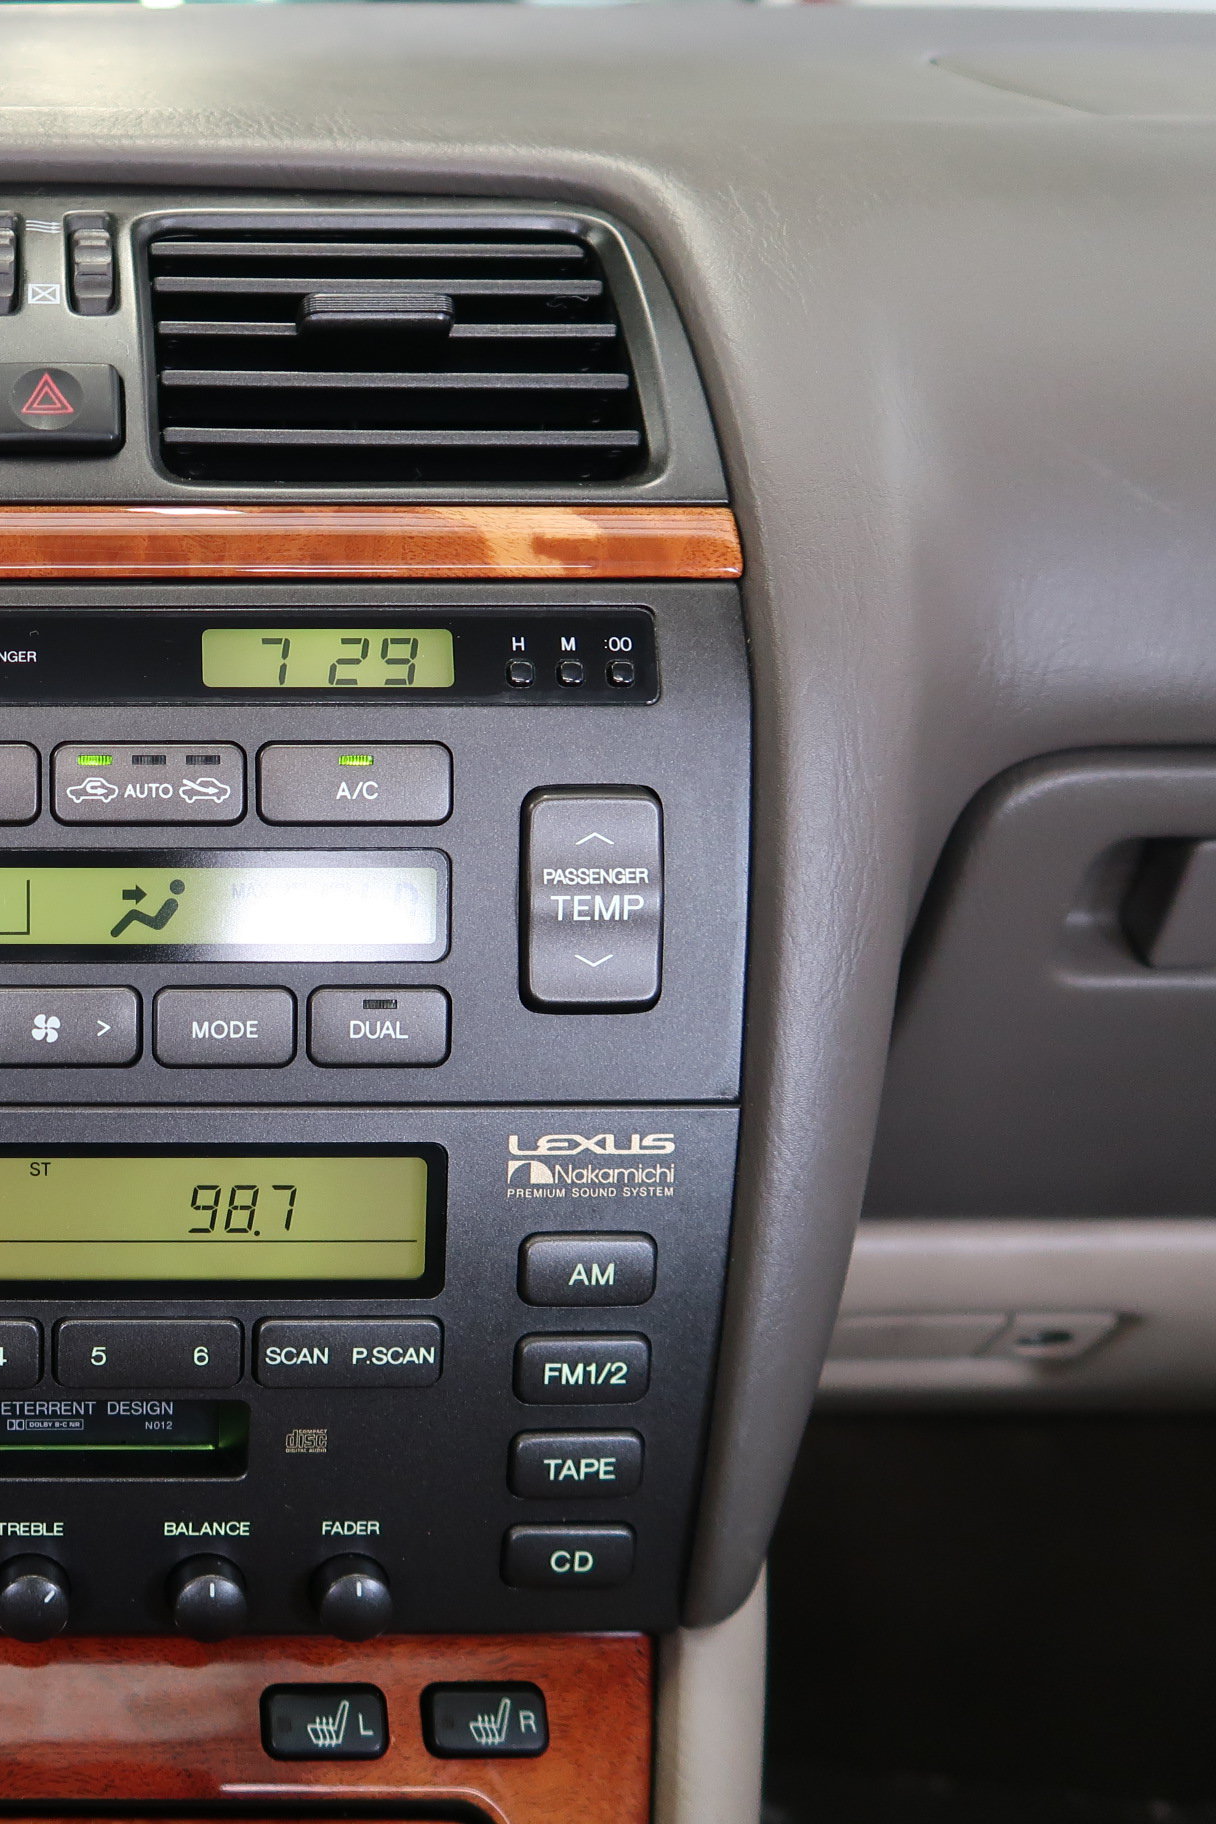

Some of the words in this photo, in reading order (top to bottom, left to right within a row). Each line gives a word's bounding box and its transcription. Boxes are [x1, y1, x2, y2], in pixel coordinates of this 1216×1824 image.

[511, 636, 525, 652] H
[560, 636, 576, 651] M
[258, 635, 292, 688] 7
[328, 635, 421, 688] 29
[123, 783, 174, 799] AUTO
[335, 780, 379, 800] A/C
[543, 867, 649, 886] PASSENGER
[550, 894, 646, 922] TEMP
[192, 1019, 259, 1039] MODE
[349, 1018, 409, 1039] DUAL
[506, 1131, 678, 1156] LEXUS
[29, 1161, 52, 1177] ST
[555, 1161, 675, 1184] Nakamichi
[505, 1186, 566, 1199] PREMIUM
[571, 1185, 617, 1199] SOUND
[622, 1185, 675, 1198] SYSTEM
[188, 1184, 297, 1237] 98.7
[568, 1262, 615, 1286] AM
[90, 1346, 107, 1366] 5
[193, 1346, 209, 1366] 6
[265, 1346, 329, 1365] SCAN
[352, 1346, 435, 1365] P.SCAN
[544, 1361, 628, 1385] FM1/2
[107, 1401, 173, 1416] DESIGN
[145, 1421, 173, 1430] N012
[543, 1457, 617, 1481] TAPE
[164, 1521, 251, 1536] BALANCE
[321, 1520, 380, 1536] FADER
[550, 1550, 594, 1573] CD
[358, 1712, 374, 1736] L
[519, 1709, 537, 1734] R
